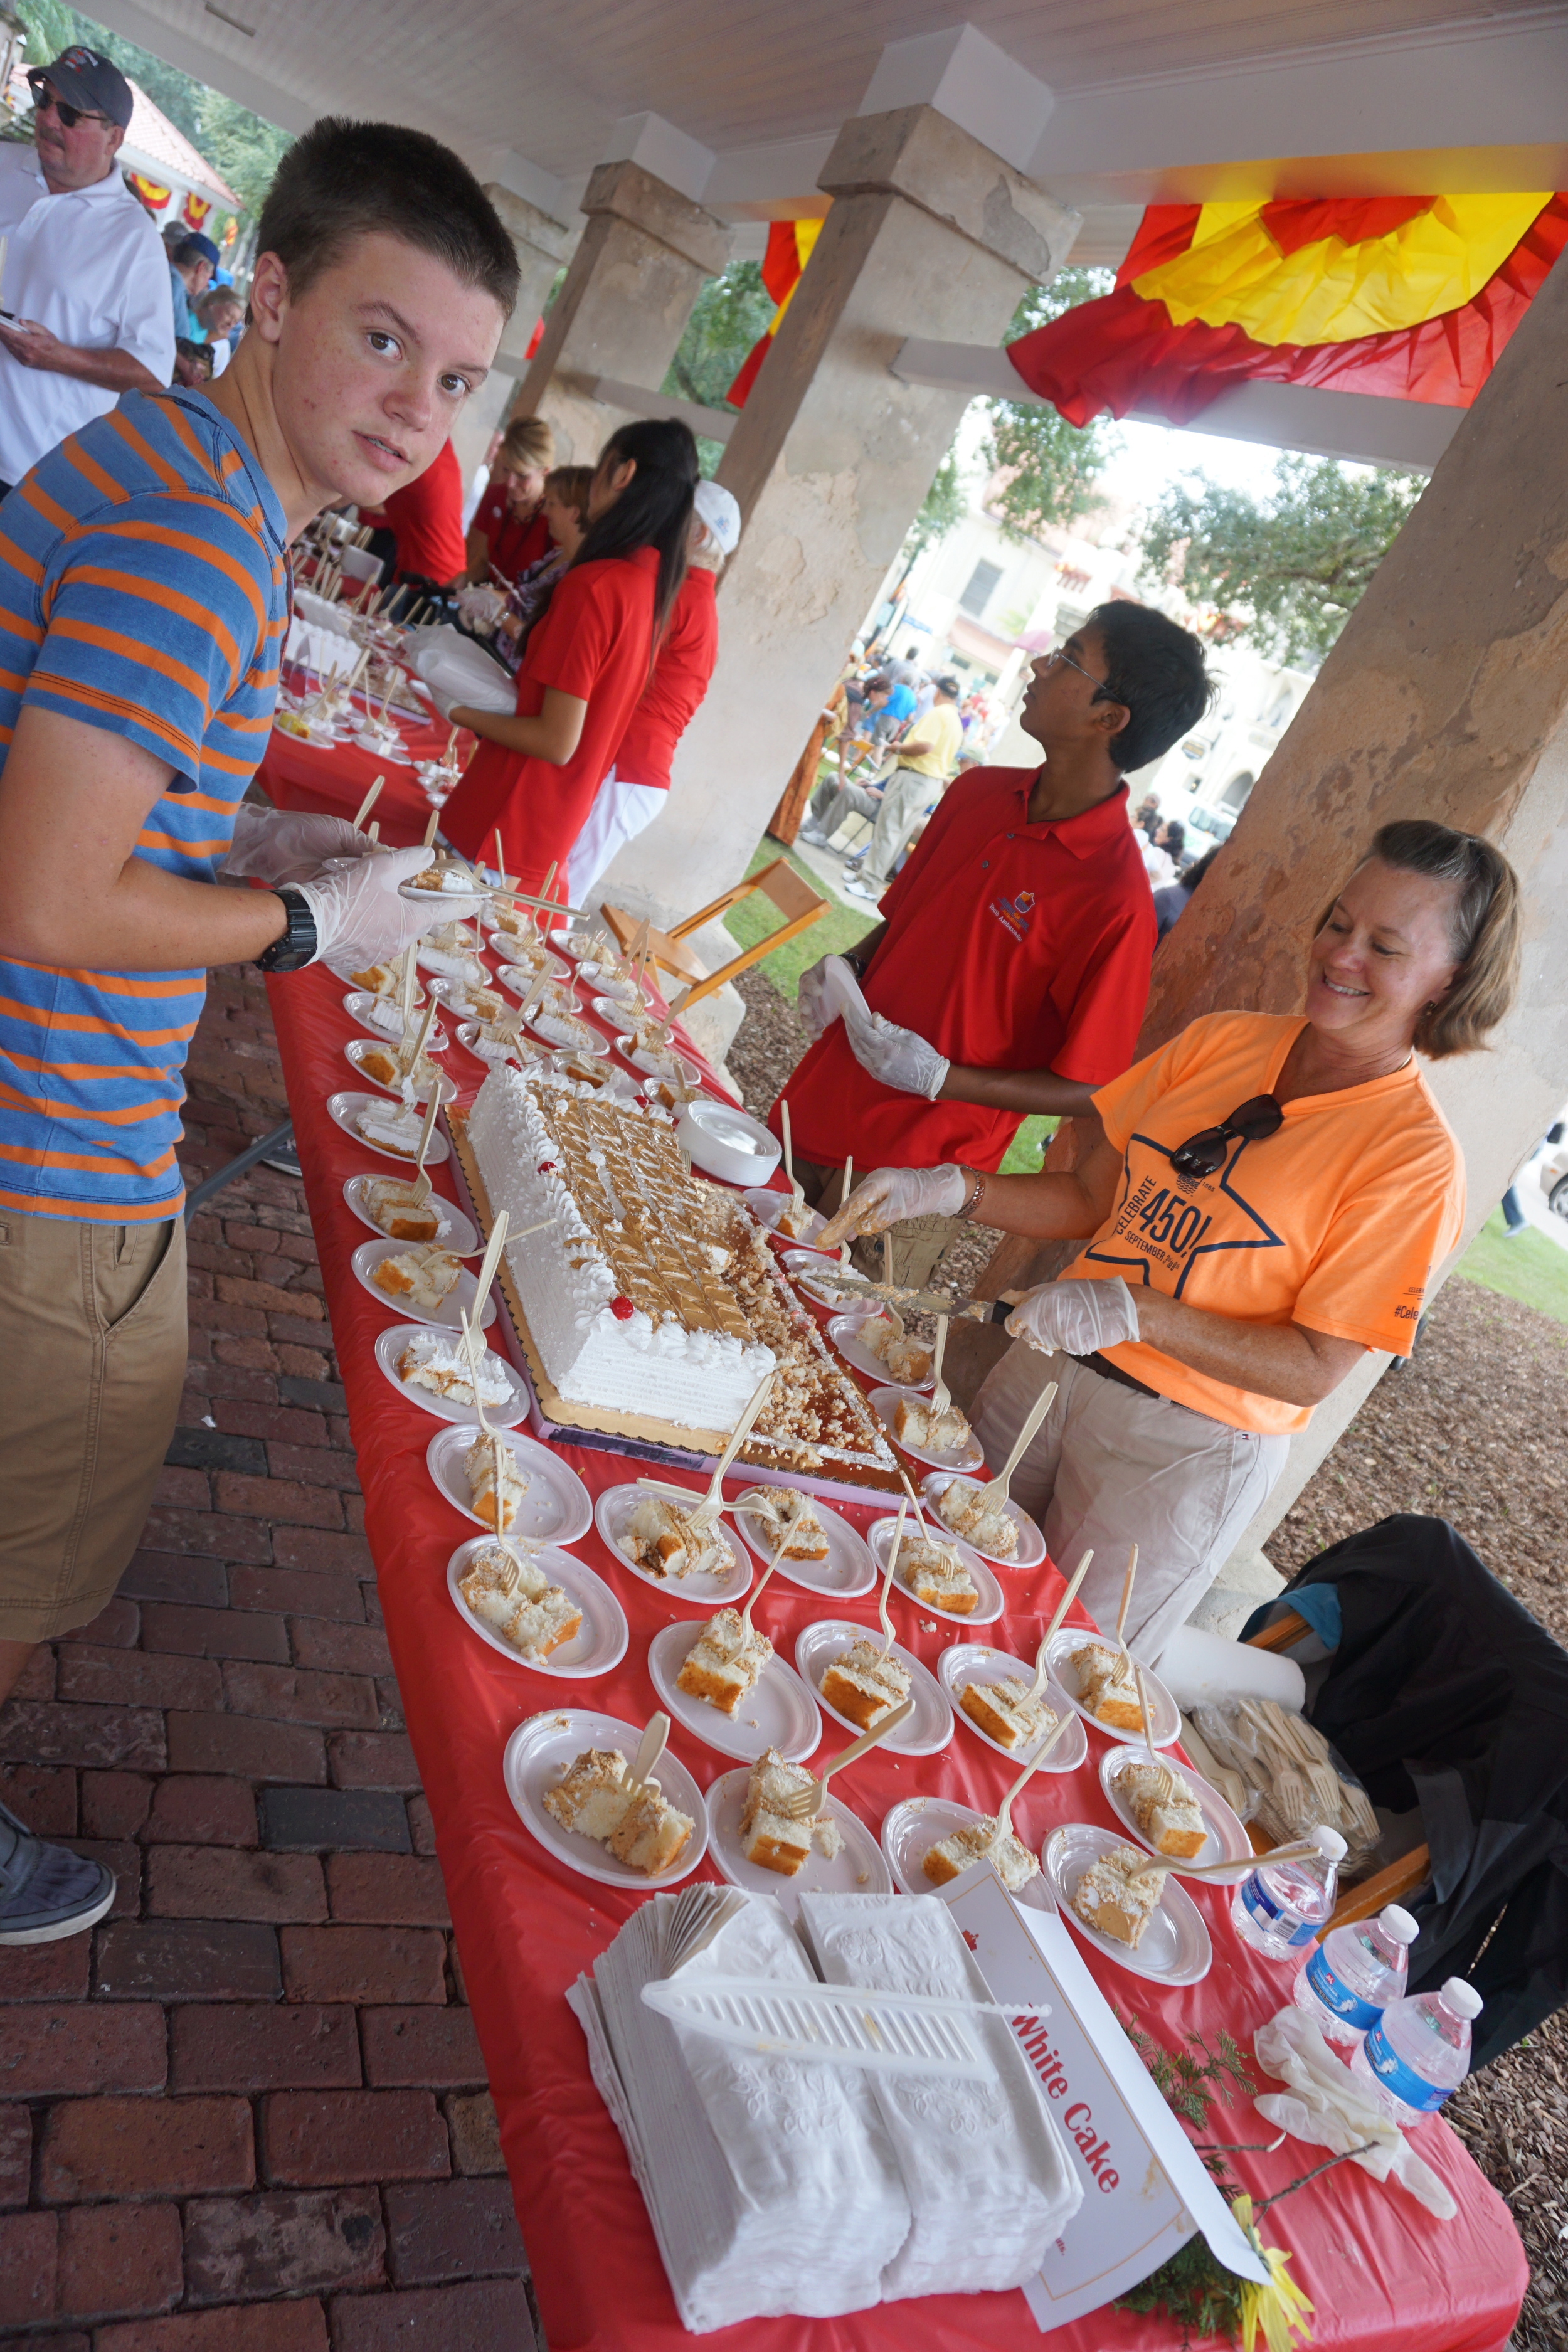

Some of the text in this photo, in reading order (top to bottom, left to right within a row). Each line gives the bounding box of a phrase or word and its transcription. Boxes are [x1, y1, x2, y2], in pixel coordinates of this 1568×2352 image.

[989, 903, 1022, 942] Youth Ambassador
[1002, 909, 1022, 930] AUGUSTINE
[1116, 1175, 1157, 1236] CELEBRATE
[1202, 1182, 1216, 1192] 1565
[1139, 1188, 1213, 1259] 450!
[1125, 1231, 1165, 1262] SEPTEMBER
[1011, 2001, 1120, 2194] White Cake
